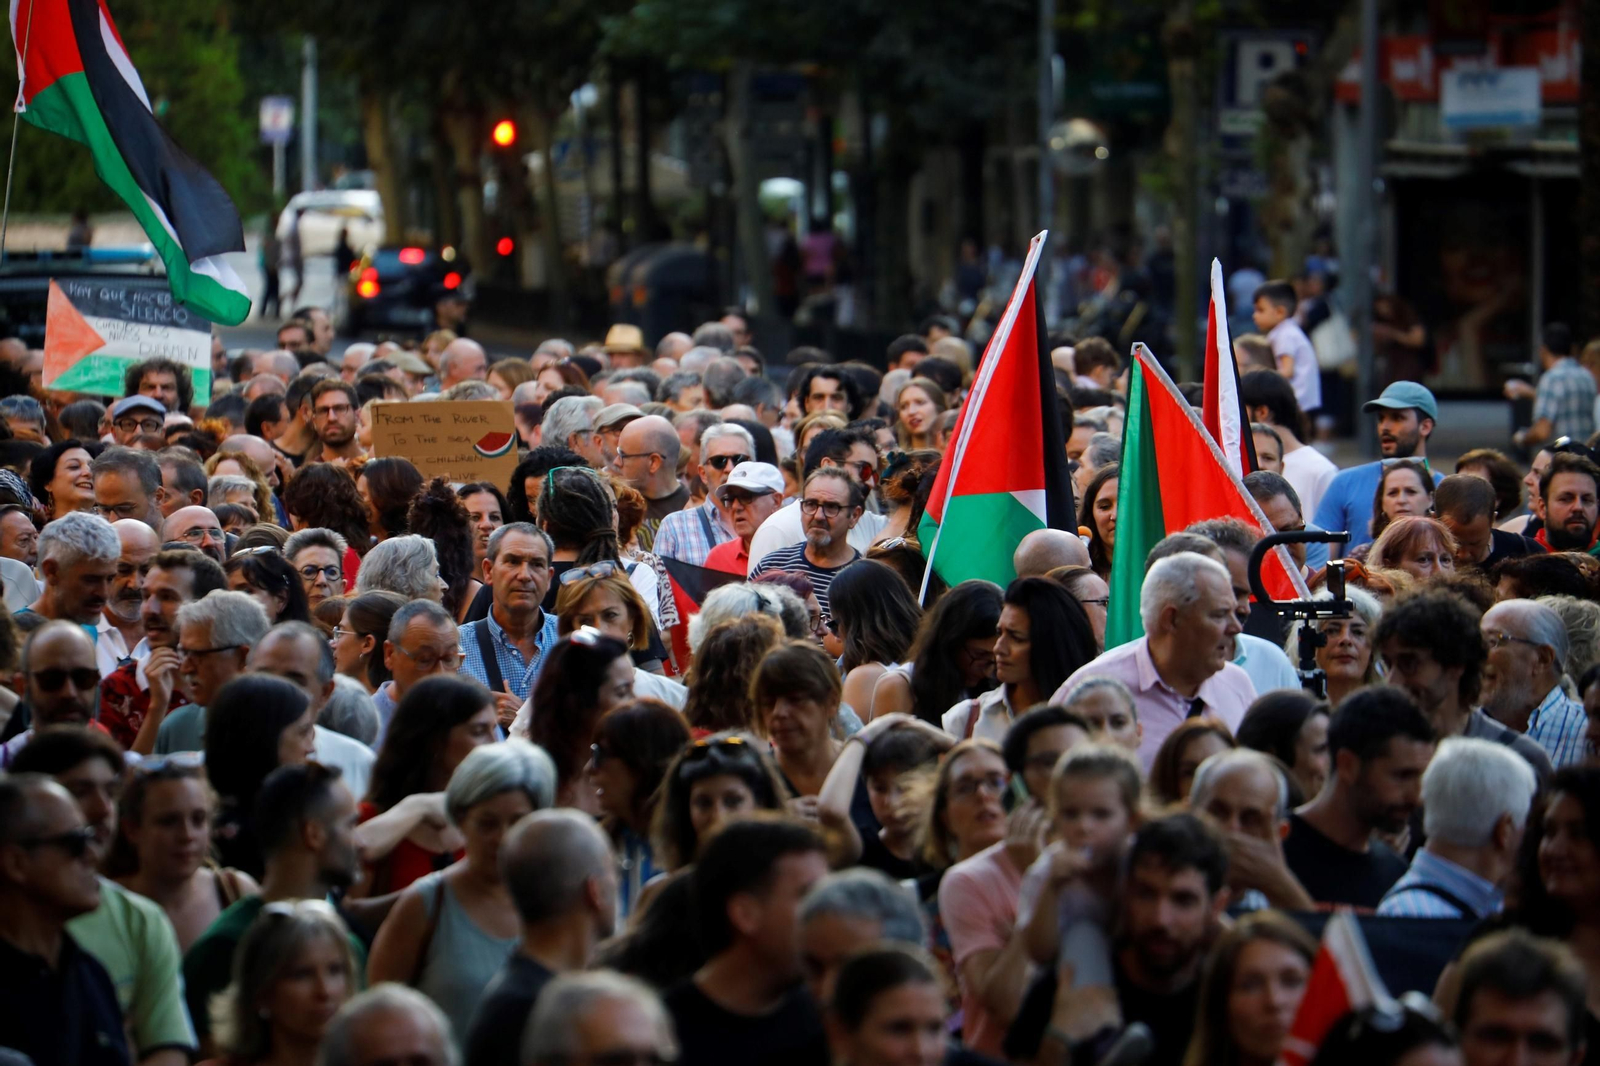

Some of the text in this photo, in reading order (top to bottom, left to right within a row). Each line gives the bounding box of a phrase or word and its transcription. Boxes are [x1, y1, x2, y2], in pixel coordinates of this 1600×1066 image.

[69, 281, 172, 306] HAY QUE HACER
[120, 301, 187, 323] SILENCIO
[95, 320, 170, 339] CUANDO LOS
[371, 405, 489, 424] FROM THE RIVER
[387, 432, 471, 446] TO THE SEA
[426, 455, 483, 465] CHILDREN
[450, 472, 478, 481] LIVE
